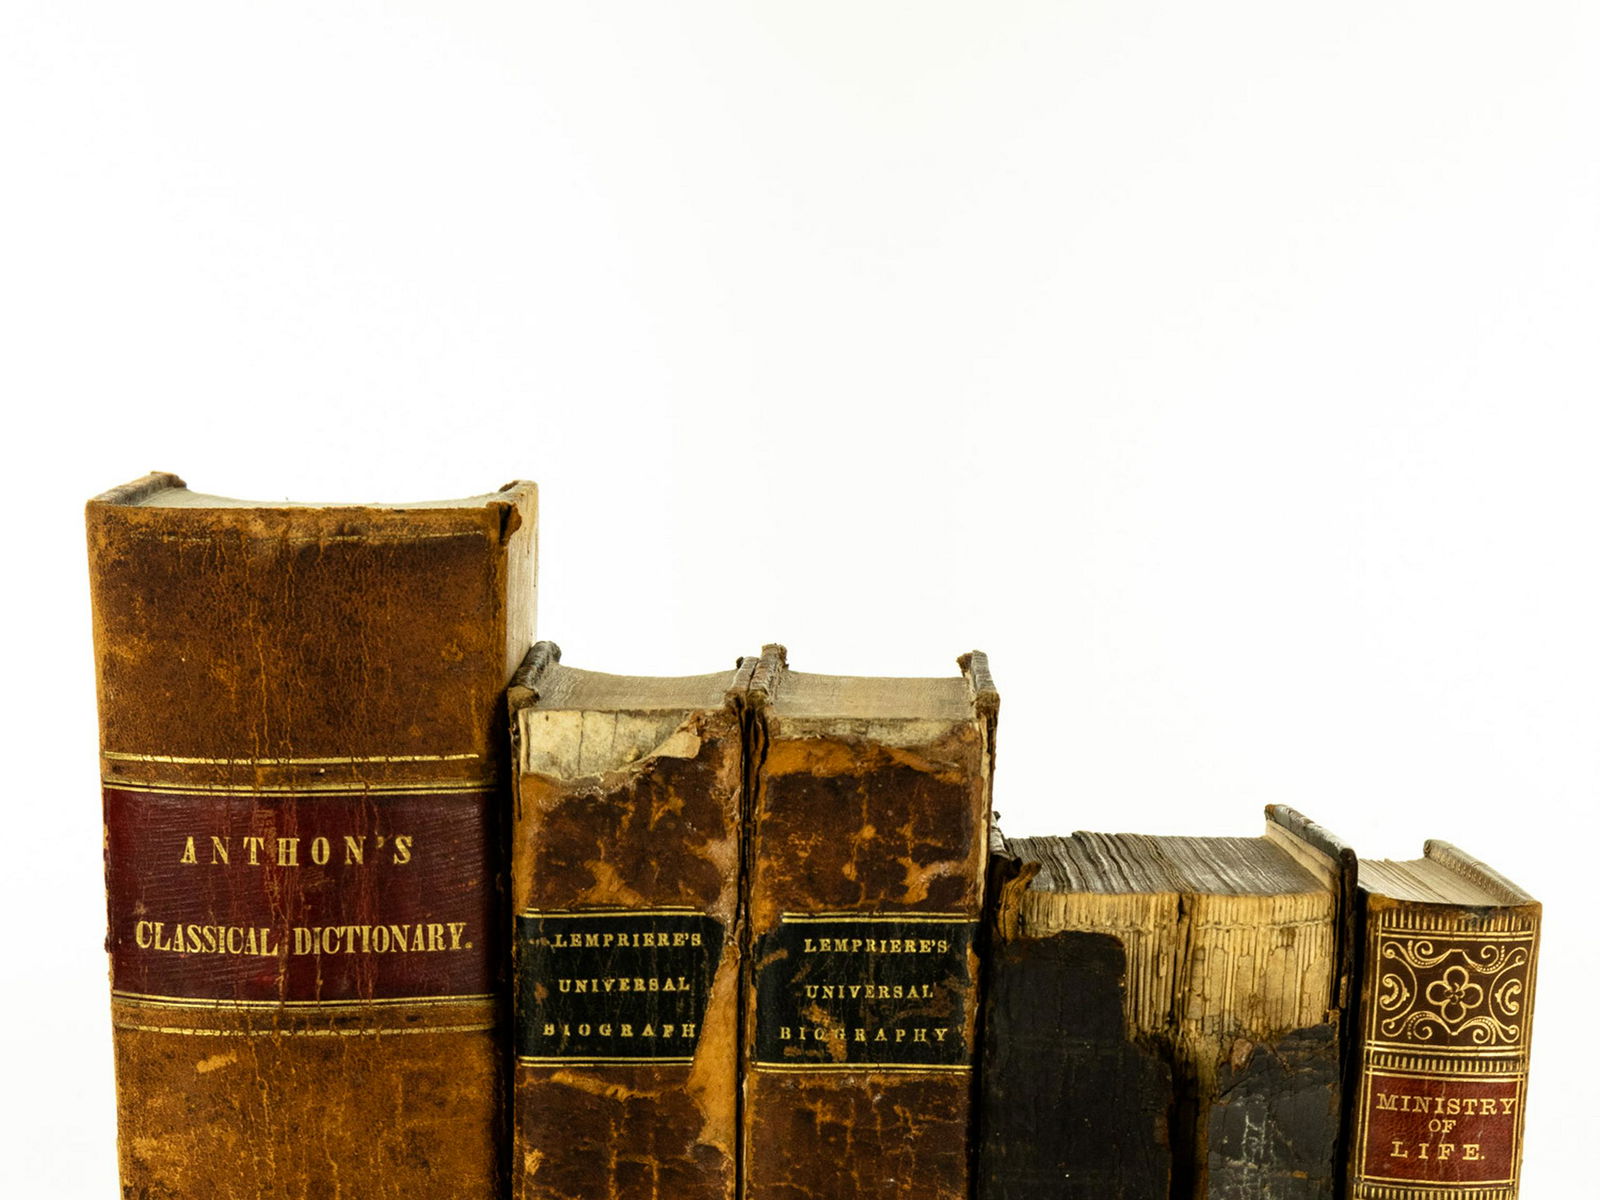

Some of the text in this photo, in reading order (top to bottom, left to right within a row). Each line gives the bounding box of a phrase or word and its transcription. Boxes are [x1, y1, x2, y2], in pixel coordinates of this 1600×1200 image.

[180, 836, 414, 866] ANTHON'S
[135, 920, 473, 956] CLASSICAL DICTIONARY.
[551, 932, 702, 948] LEMPRIERE'S
[804, 938, 948, 954] LEMPRIERE'S
[558, 976, 690, 993] UNIVERSAL
[806, 984, 934, 999] UNIVERSAL
[542, 1023, 697, 1038] BIOGRAPH
[779, 1027, 948, 1042] BIOGRAPHY
[1376, 1093, 1516, 1115] MINISTRY
[1428, 1118, 1457, 1134] OF
[1390, 1140, 1486, 1161] LIFE.
